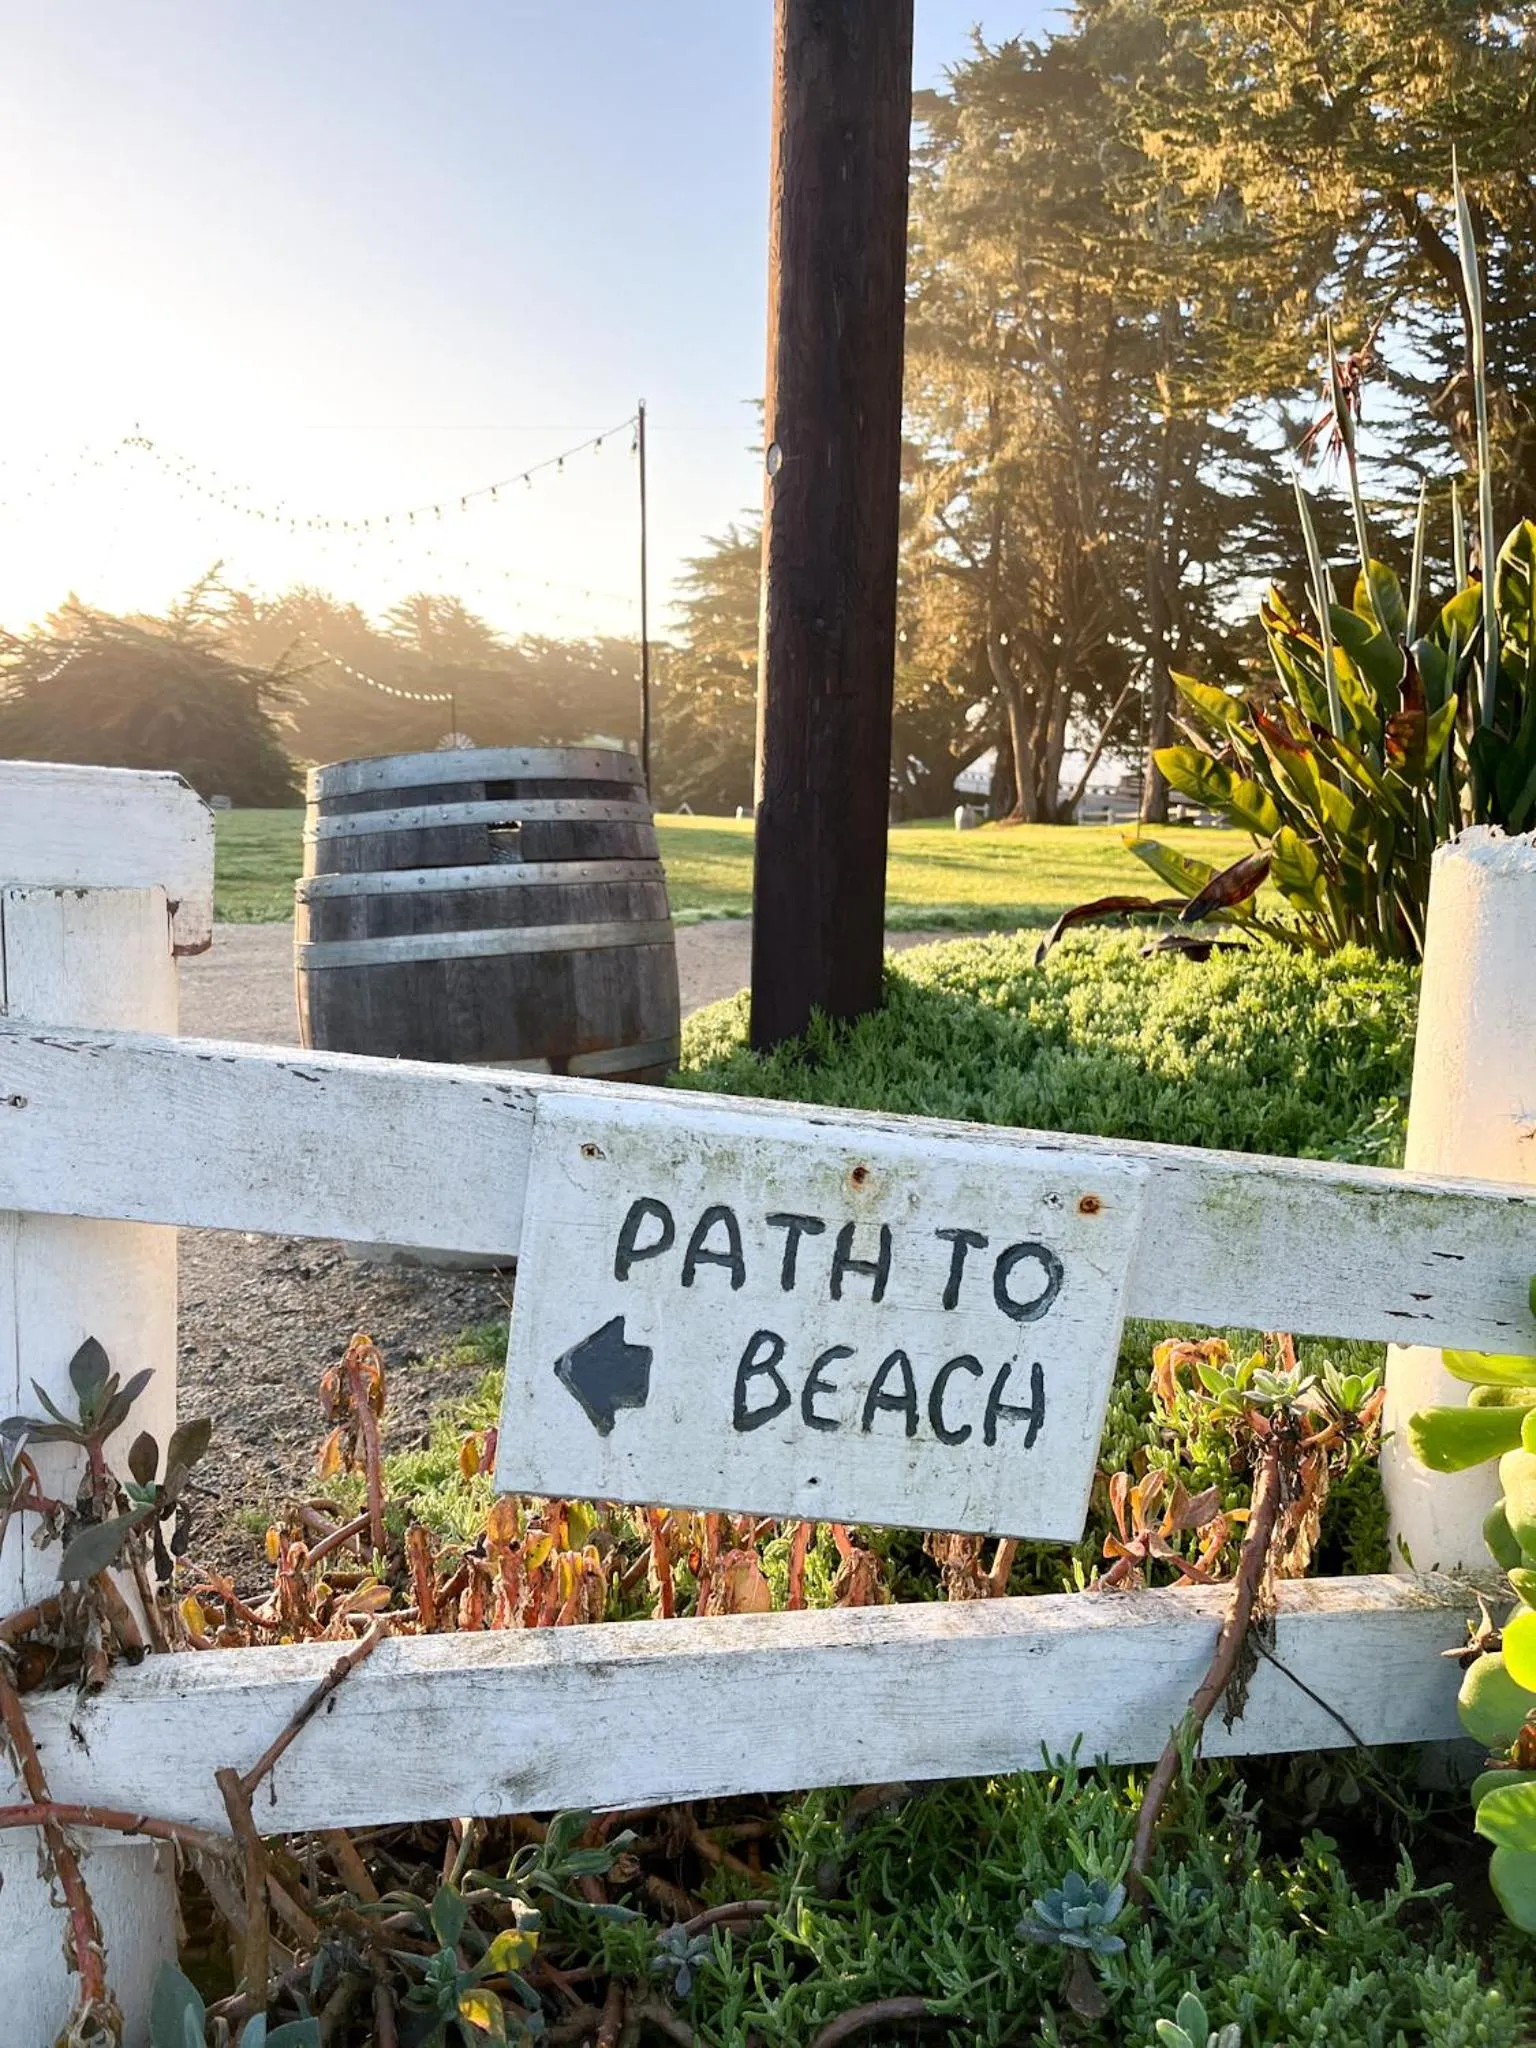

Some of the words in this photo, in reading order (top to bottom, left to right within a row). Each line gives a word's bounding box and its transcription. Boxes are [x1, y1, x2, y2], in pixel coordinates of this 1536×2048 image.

[614, 1196, 893, 1303] PATH
[934, 1228, 1065, 1323] TO
[732, 1329, 1046, 1450] BEACH
